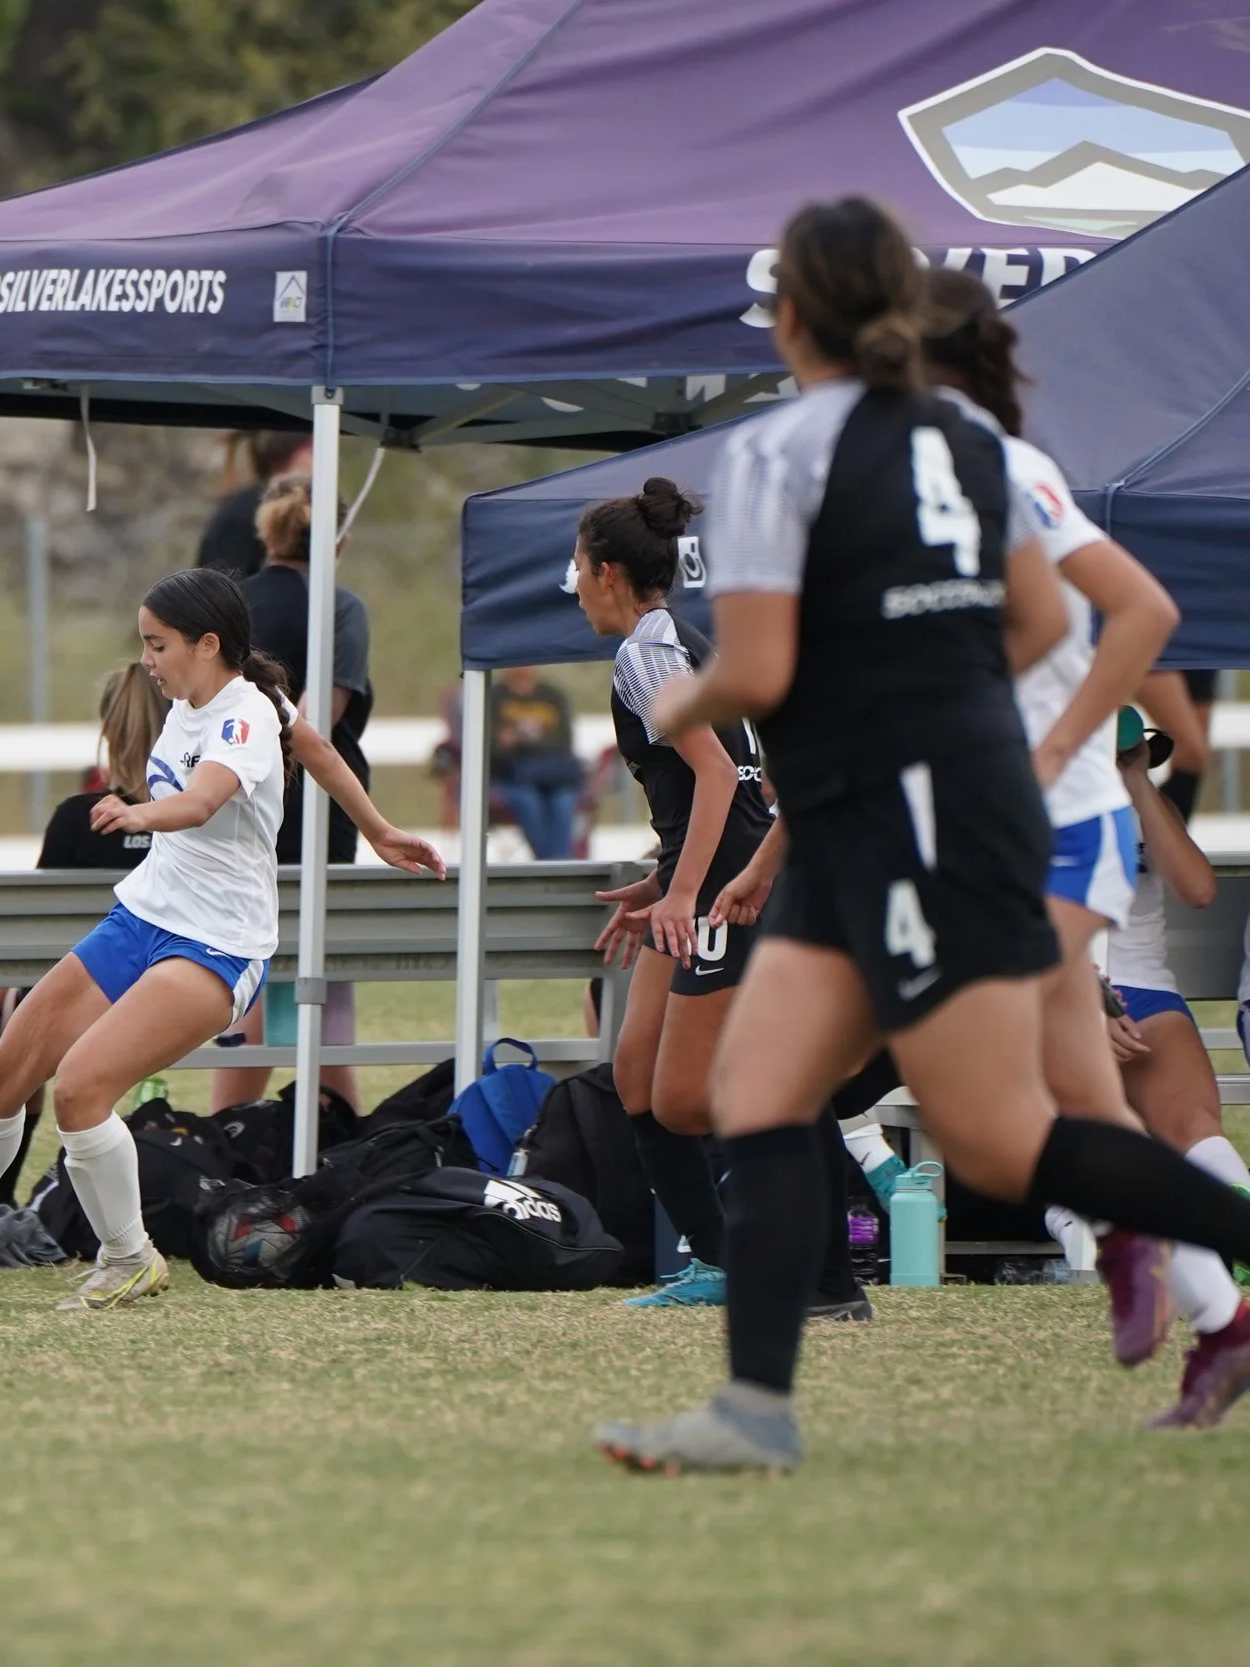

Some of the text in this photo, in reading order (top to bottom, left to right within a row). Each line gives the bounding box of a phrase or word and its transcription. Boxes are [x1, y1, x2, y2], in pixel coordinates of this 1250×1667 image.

[911, 425, 982, 578] 4
[123, 835, 151, 849] LOS
[690, 916, 728, 961] 0
[885, 878, 937, 969] 4
[502, 1196, 562, 1223] didas
